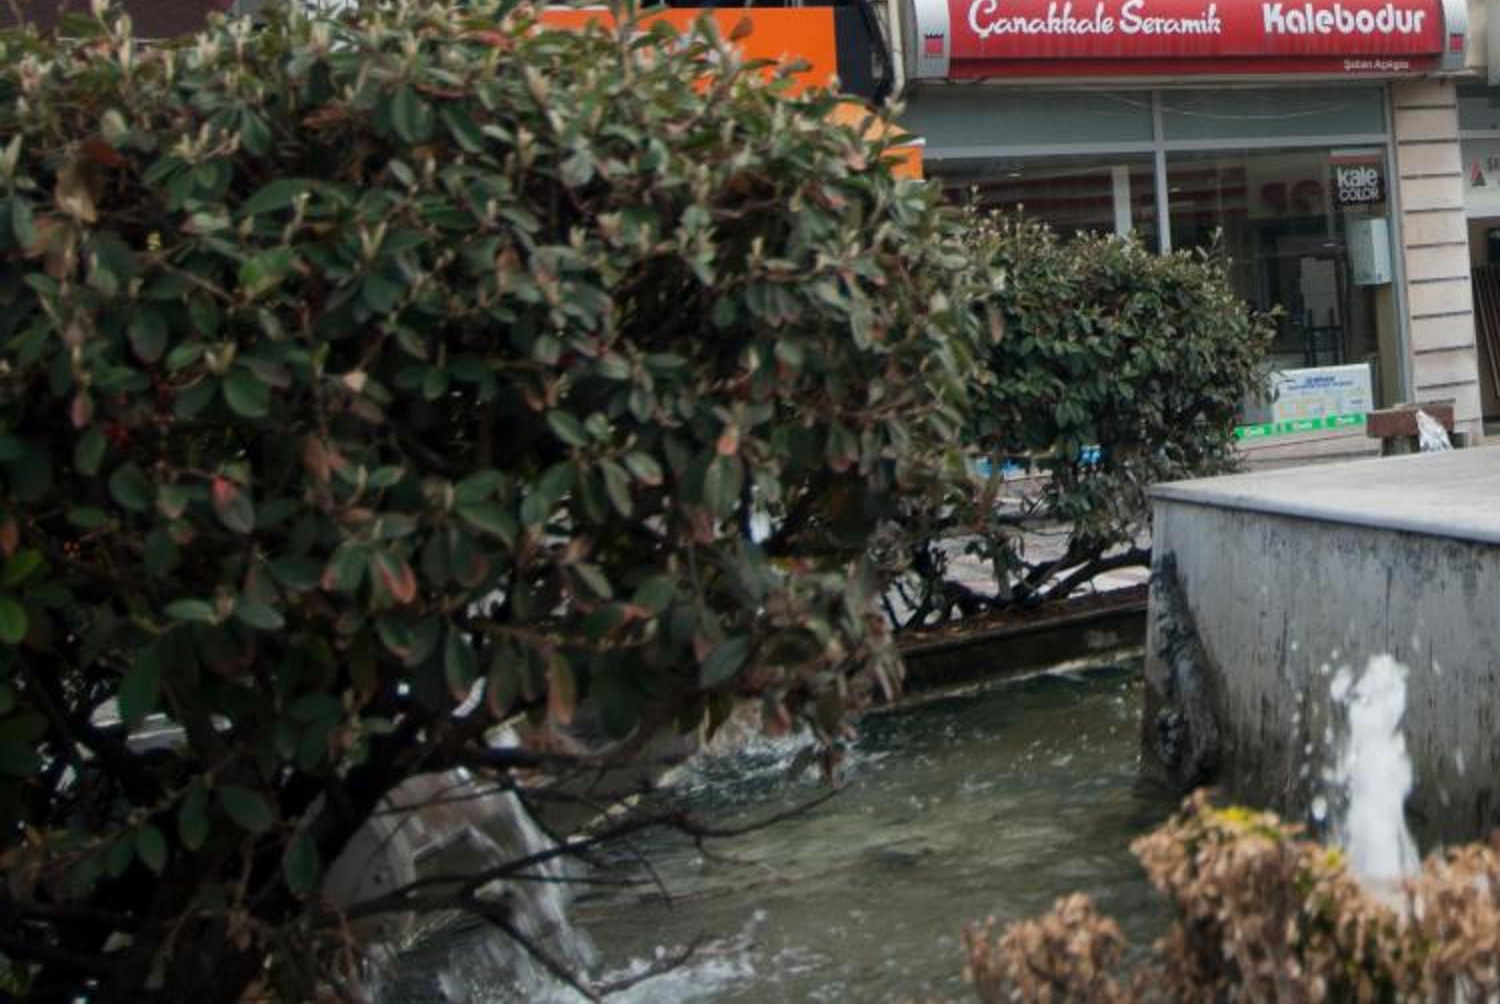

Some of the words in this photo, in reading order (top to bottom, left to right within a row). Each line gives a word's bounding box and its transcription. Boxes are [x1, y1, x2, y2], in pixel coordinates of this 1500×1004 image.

[1262, 2, 1426, 36] Kalebodur
[1337, 165, 1378, 188] kale
[1339, 187, 1380, 203] COLOR
